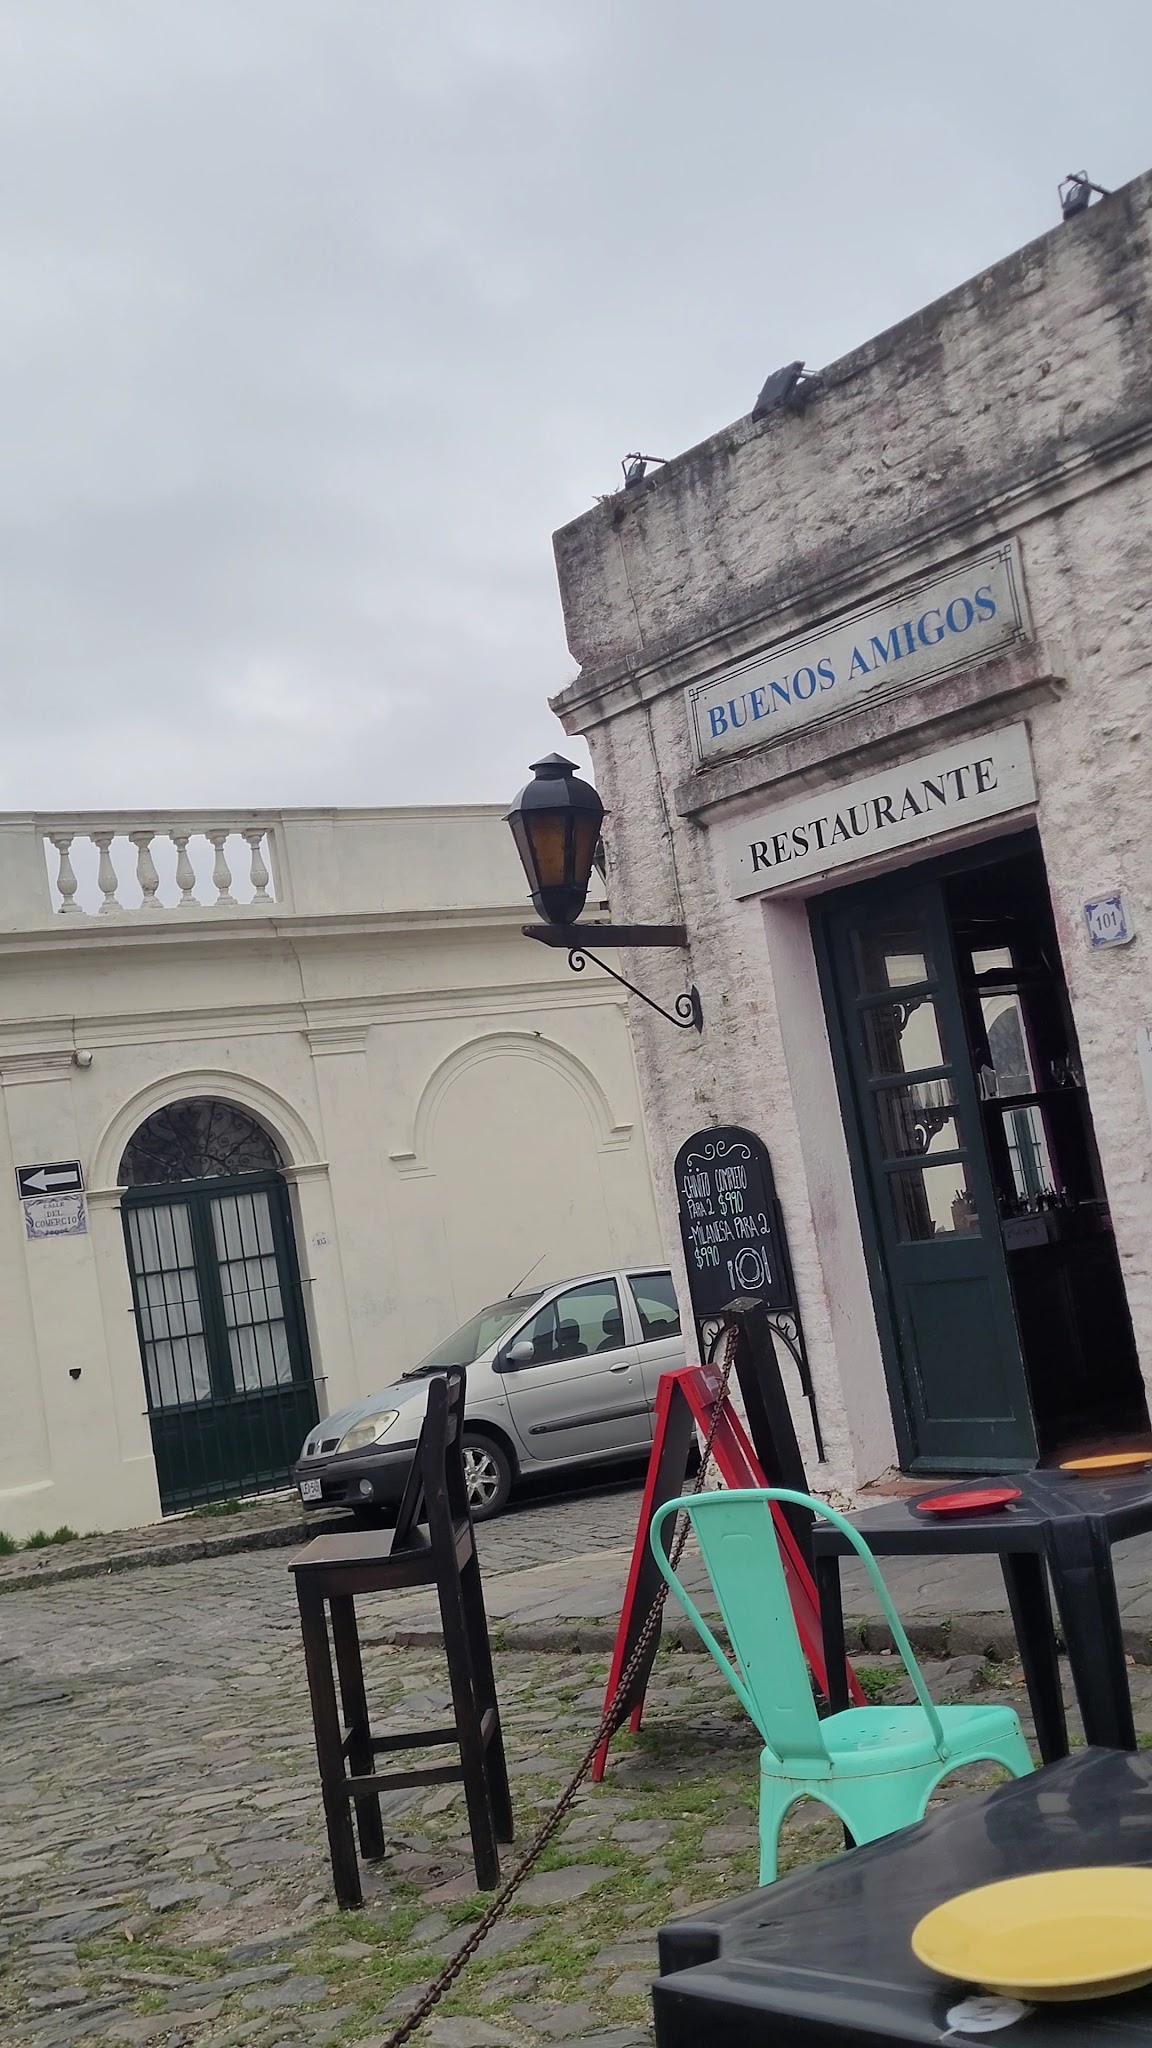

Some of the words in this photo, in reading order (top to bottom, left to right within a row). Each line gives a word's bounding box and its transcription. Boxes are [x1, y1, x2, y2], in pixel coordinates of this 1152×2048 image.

[706, 657, 836, 738] BUENOS
[847, 584, 997, 680] AMIGOS
[748, 757, 999, 874] RESTAURANTE
[1096, 911, 1117, 931] 101
[687, 1199, 707, 1219] PARA
[706, 1198, 715, 1215] 2
[718, 1191, 744, 1216] $990
[35, 1216, 77, 1228] COMERCIO
[733, 1215, 759, 1239] PARA
[758, 1213, 770, 1234] 2
[695, 1246, 720, 1269] $990
